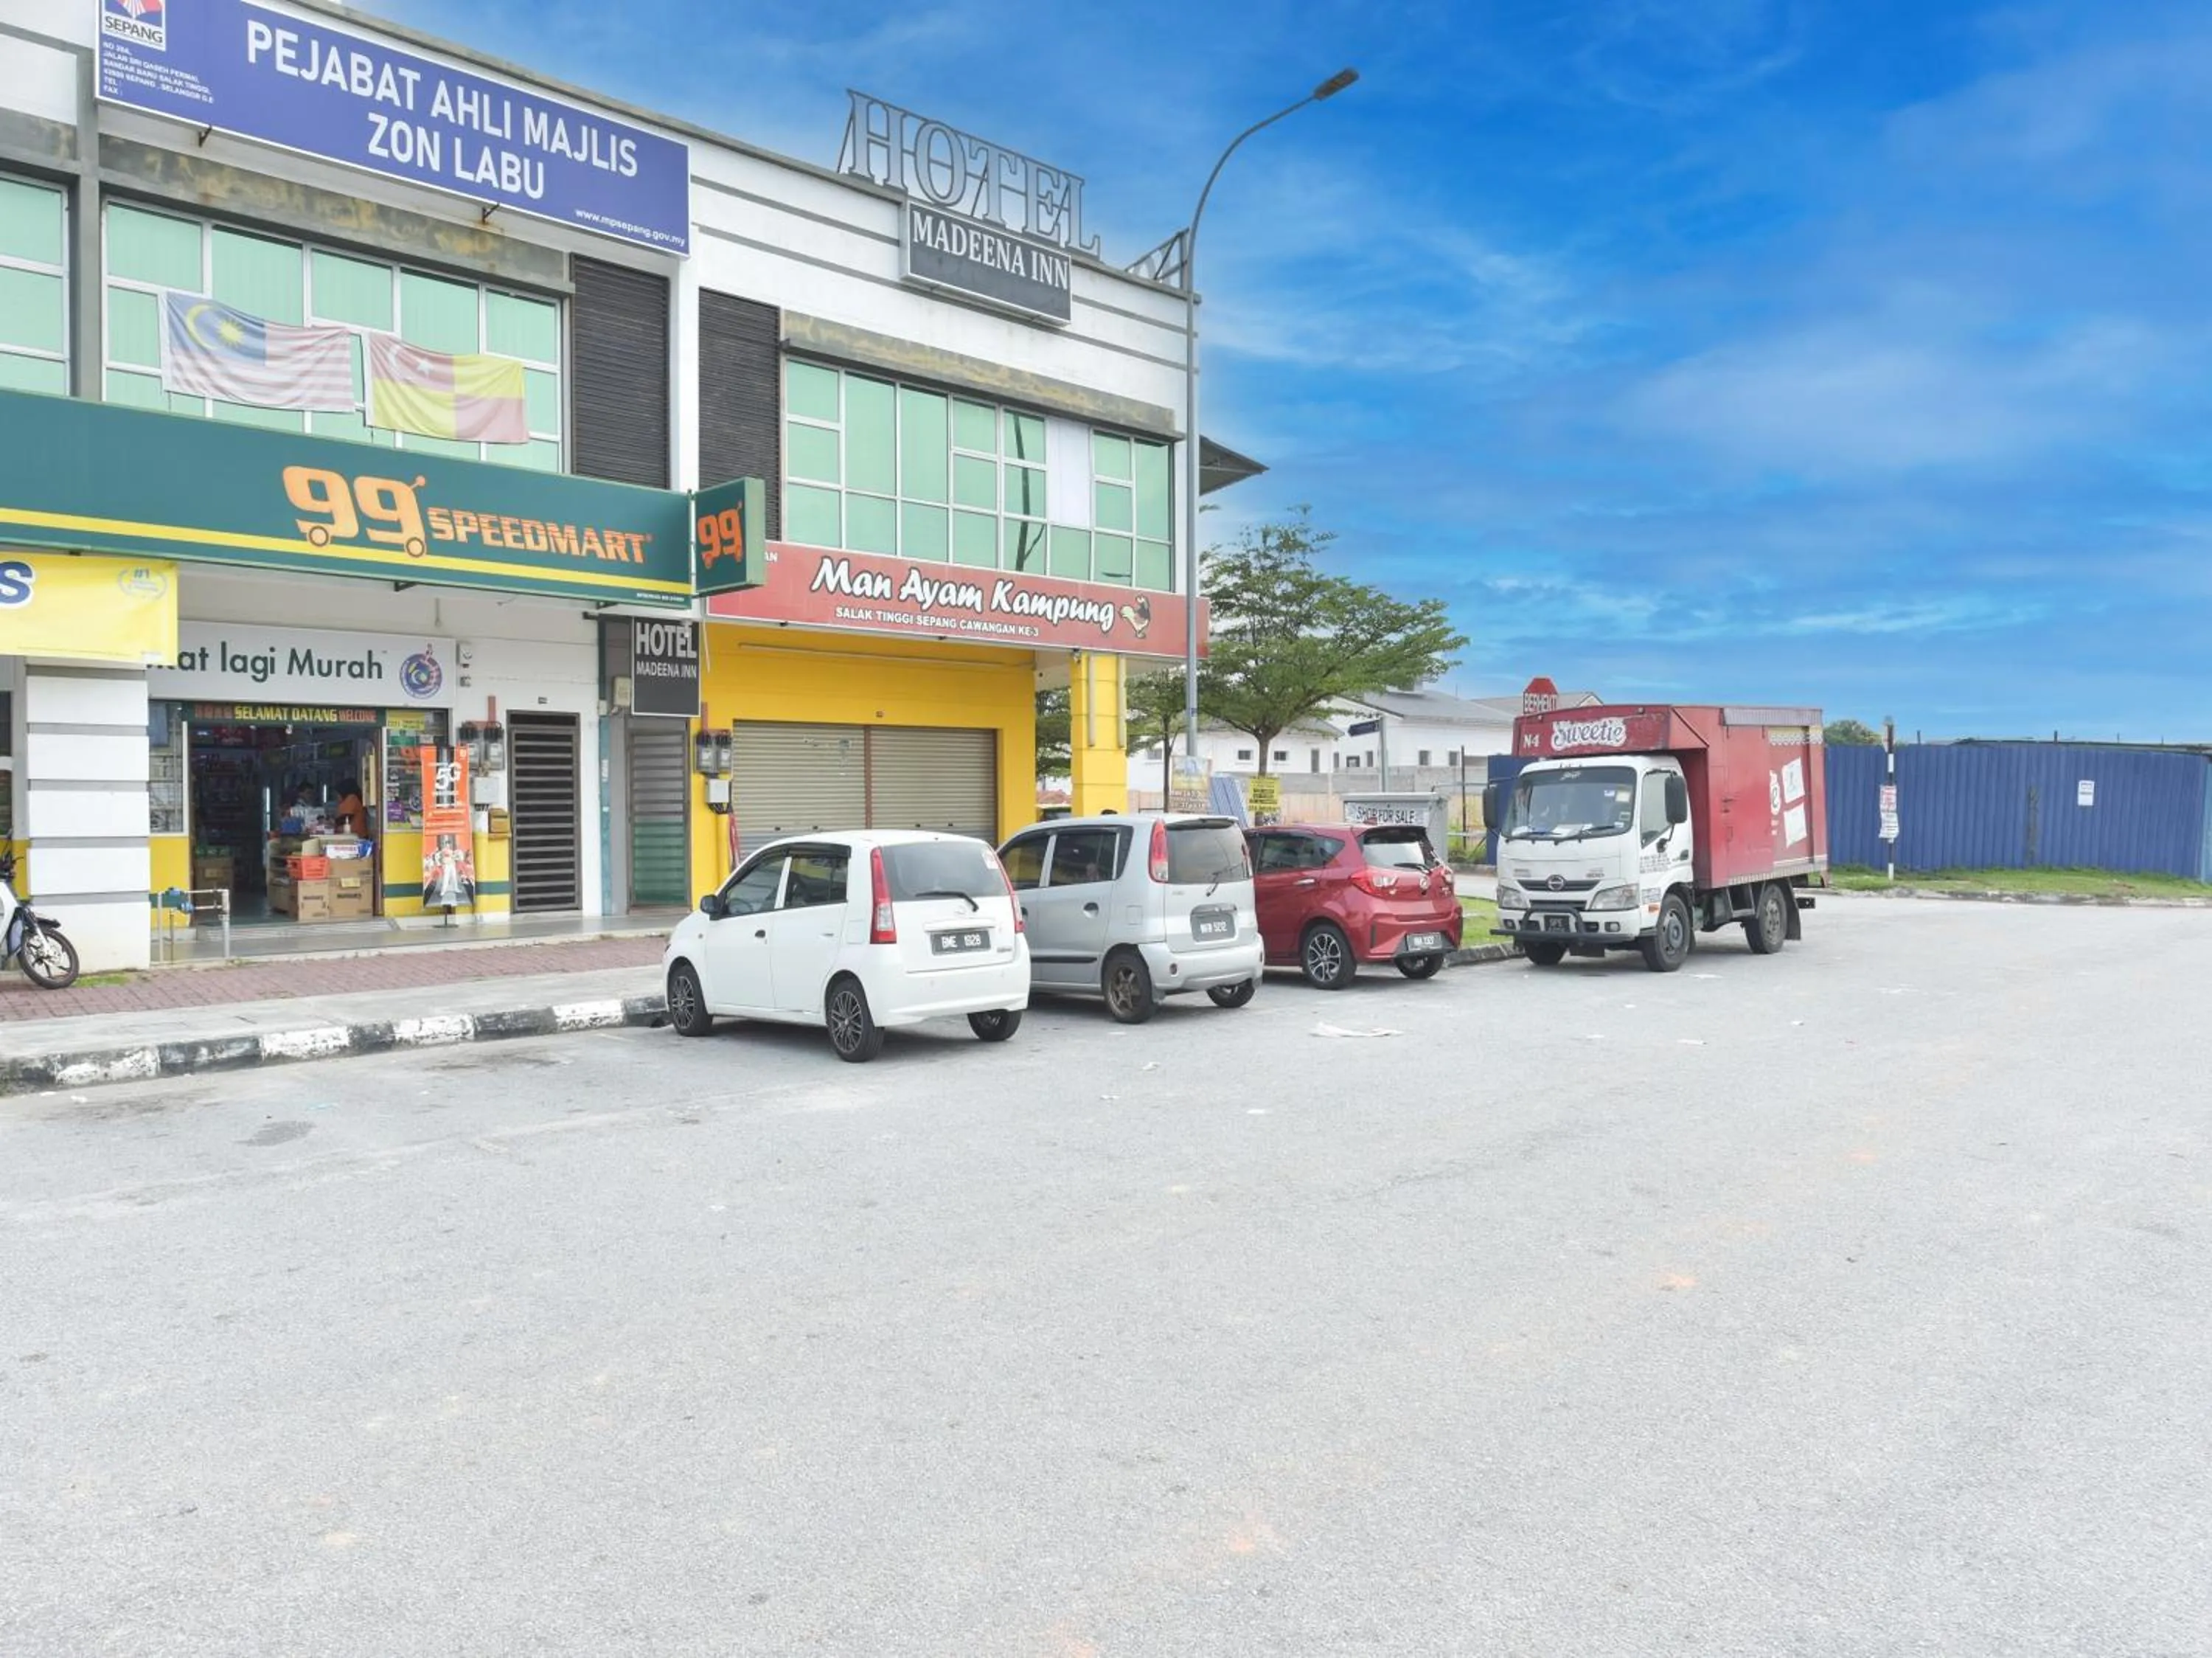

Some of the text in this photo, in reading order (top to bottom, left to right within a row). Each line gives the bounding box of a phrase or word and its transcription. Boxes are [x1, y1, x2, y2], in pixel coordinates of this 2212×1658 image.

[105, 15, 163, 44] SEPANG
[248, 20, 638, 178] PEJABAT AHLI MAJLIS
[367, 114, 544, 199] ZON LABU
[847, 89, 1101, 260] HOTEL
[912, 209, 1068, 291] MADEENA INN
[282, 465, 644, 564] 99 SPEEDMART
[698, 507, 742, 569] 99
[811, 556, 1116, 633] Man Ayam Kampung
[636, 621, 698, 659] HOTEL
[835, 607, 873, 620] SALAK
[876, 611, 914, 625] TINGGI
[917, 616, 957, 629] SEPANG
[960, 620, 1016, 635] CAWANGAN
[220, 641, 276, 683] lagi
[287, 648, 383, 679] Murah
[636, 661, 698, 679] MADEENA INN
[234, 705, 290, 722] SELAMAT
[293, 706, 338, 723] DATANG
[435, 761, 462, 790] 5G
[1395, 810, 1416, 824] SALE
